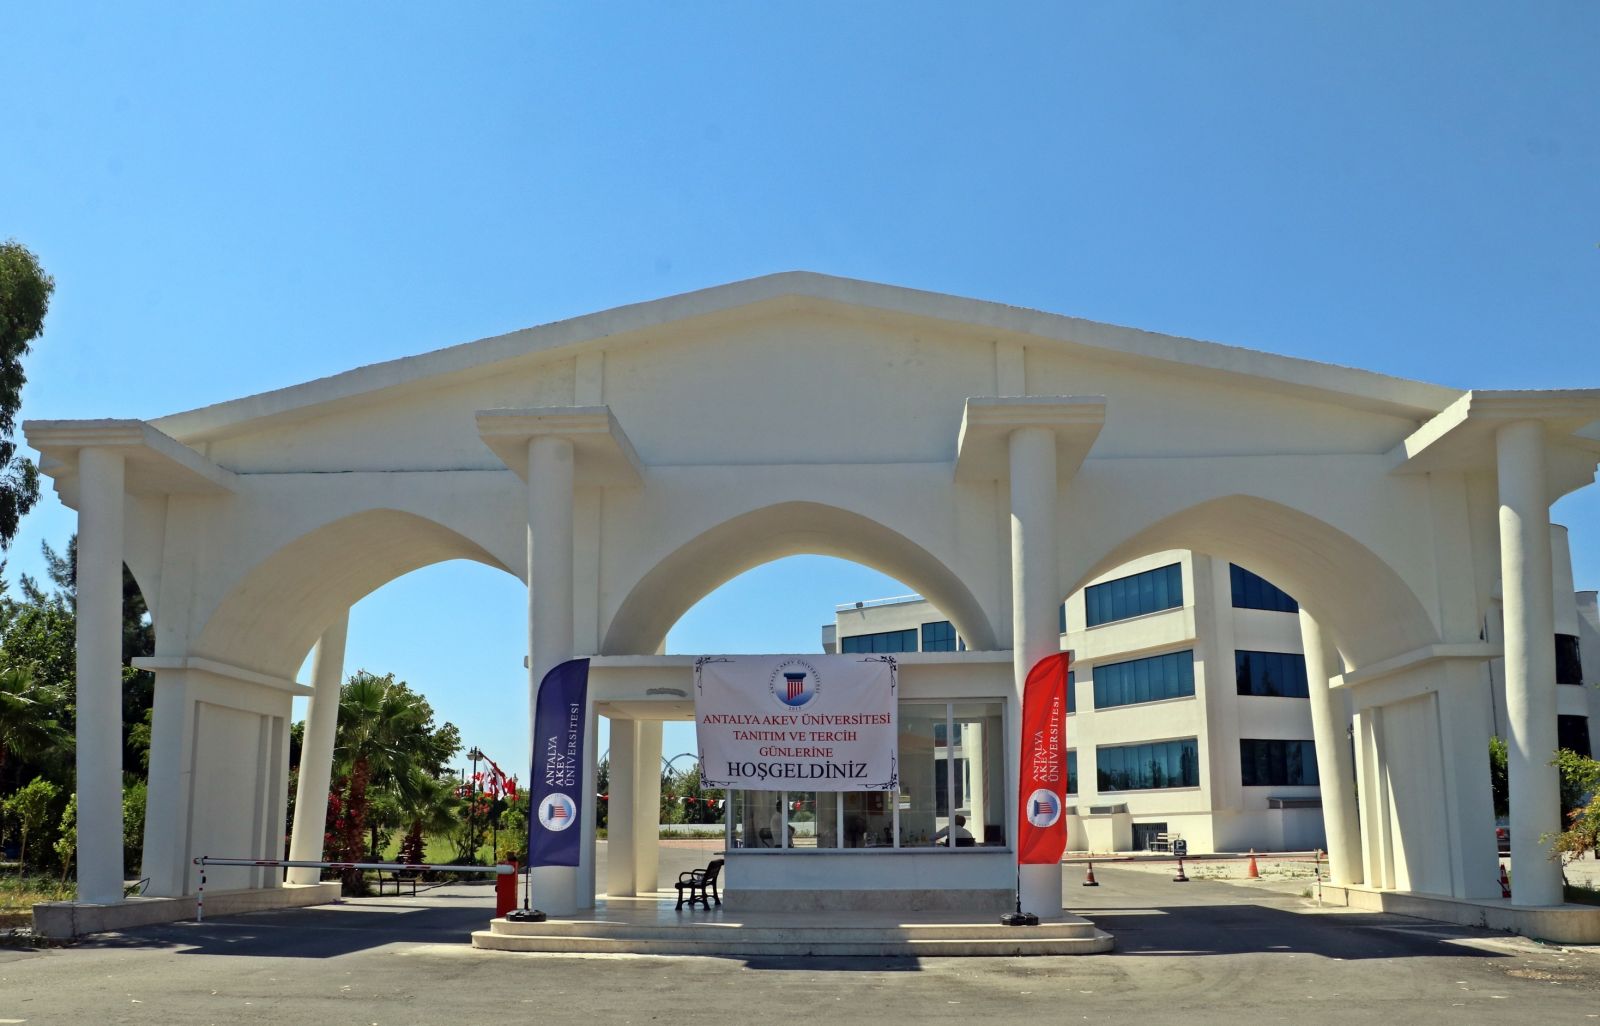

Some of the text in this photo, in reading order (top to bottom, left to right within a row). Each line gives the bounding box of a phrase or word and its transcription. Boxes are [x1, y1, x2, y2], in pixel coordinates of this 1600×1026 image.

[703, 712, 891, 726] ANTALYA AKEV ÜNİVERSİTESİ
[565, 703, 580, 787] ÜNİVERSİTESİ
[733, 729, 857, 741] TANITIM VE TERCİH
[1048, 696, 1060, 782] ÜNİVERSİTESİ
[546, 736, 558, 786] ANTALYA
[759, 745, 833, 757] GÜNLERİNE
[1032, 731, 1044, 782] ANTALYA
[555, 753, 565, 786] AKEV
[728, 760, 868, 780] HOŞGELDİNİZ
[1176, 841, 1184, 849] P
